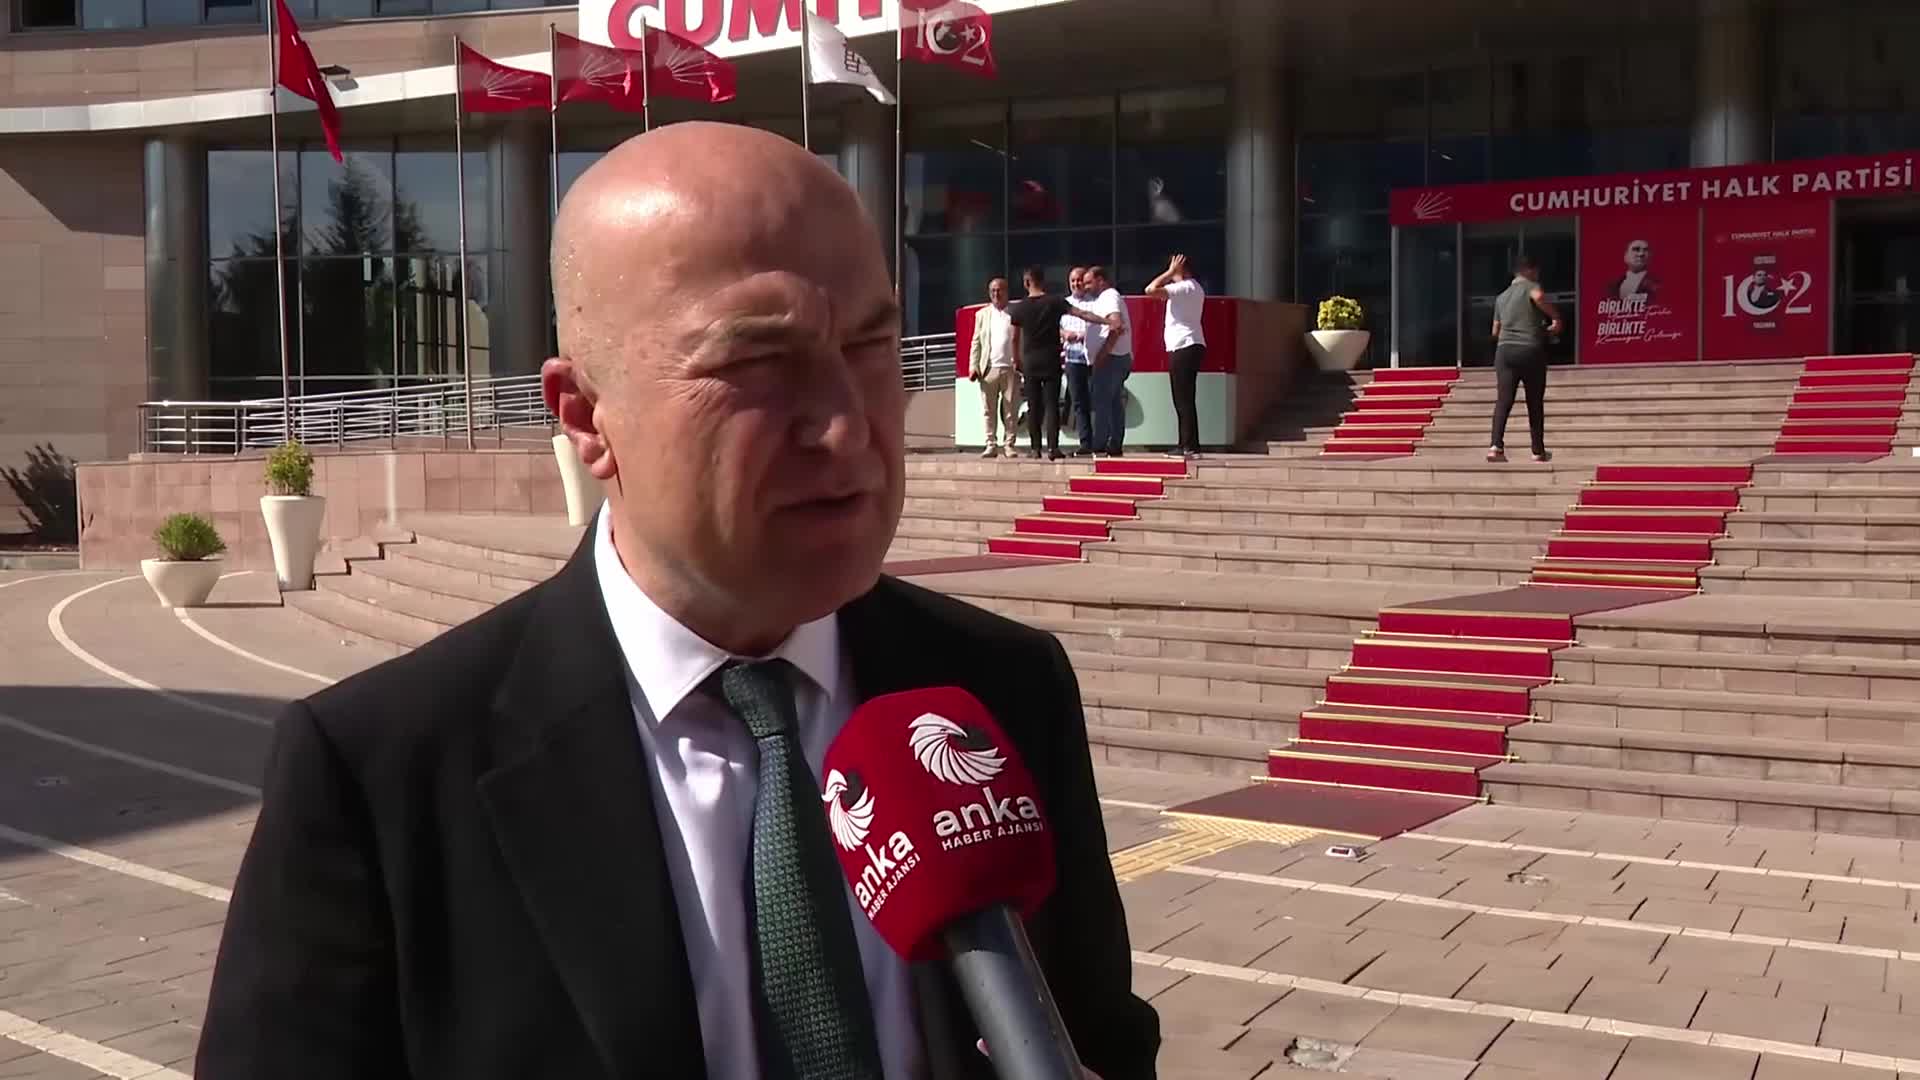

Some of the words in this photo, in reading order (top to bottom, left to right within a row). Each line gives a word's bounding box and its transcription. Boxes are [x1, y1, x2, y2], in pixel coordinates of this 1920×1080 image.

[1510, 179, 1691, 212] CUMHURİYET
[1702, 175, 1780, 199] HALK
[1792, 158, 1912, 192] PARTİSİ
[1597, 320, 1647, 335] BİRLİKTE
[933, 786, 1040, 836] anka
[942, 829, 993, 851] HABER
[997, 821, 1043, 837] AJANSI
[855, 831, 914, 908] anka
[868, 889, 889, 920] HABER
[886, 852, 921, 892] AJANSI
